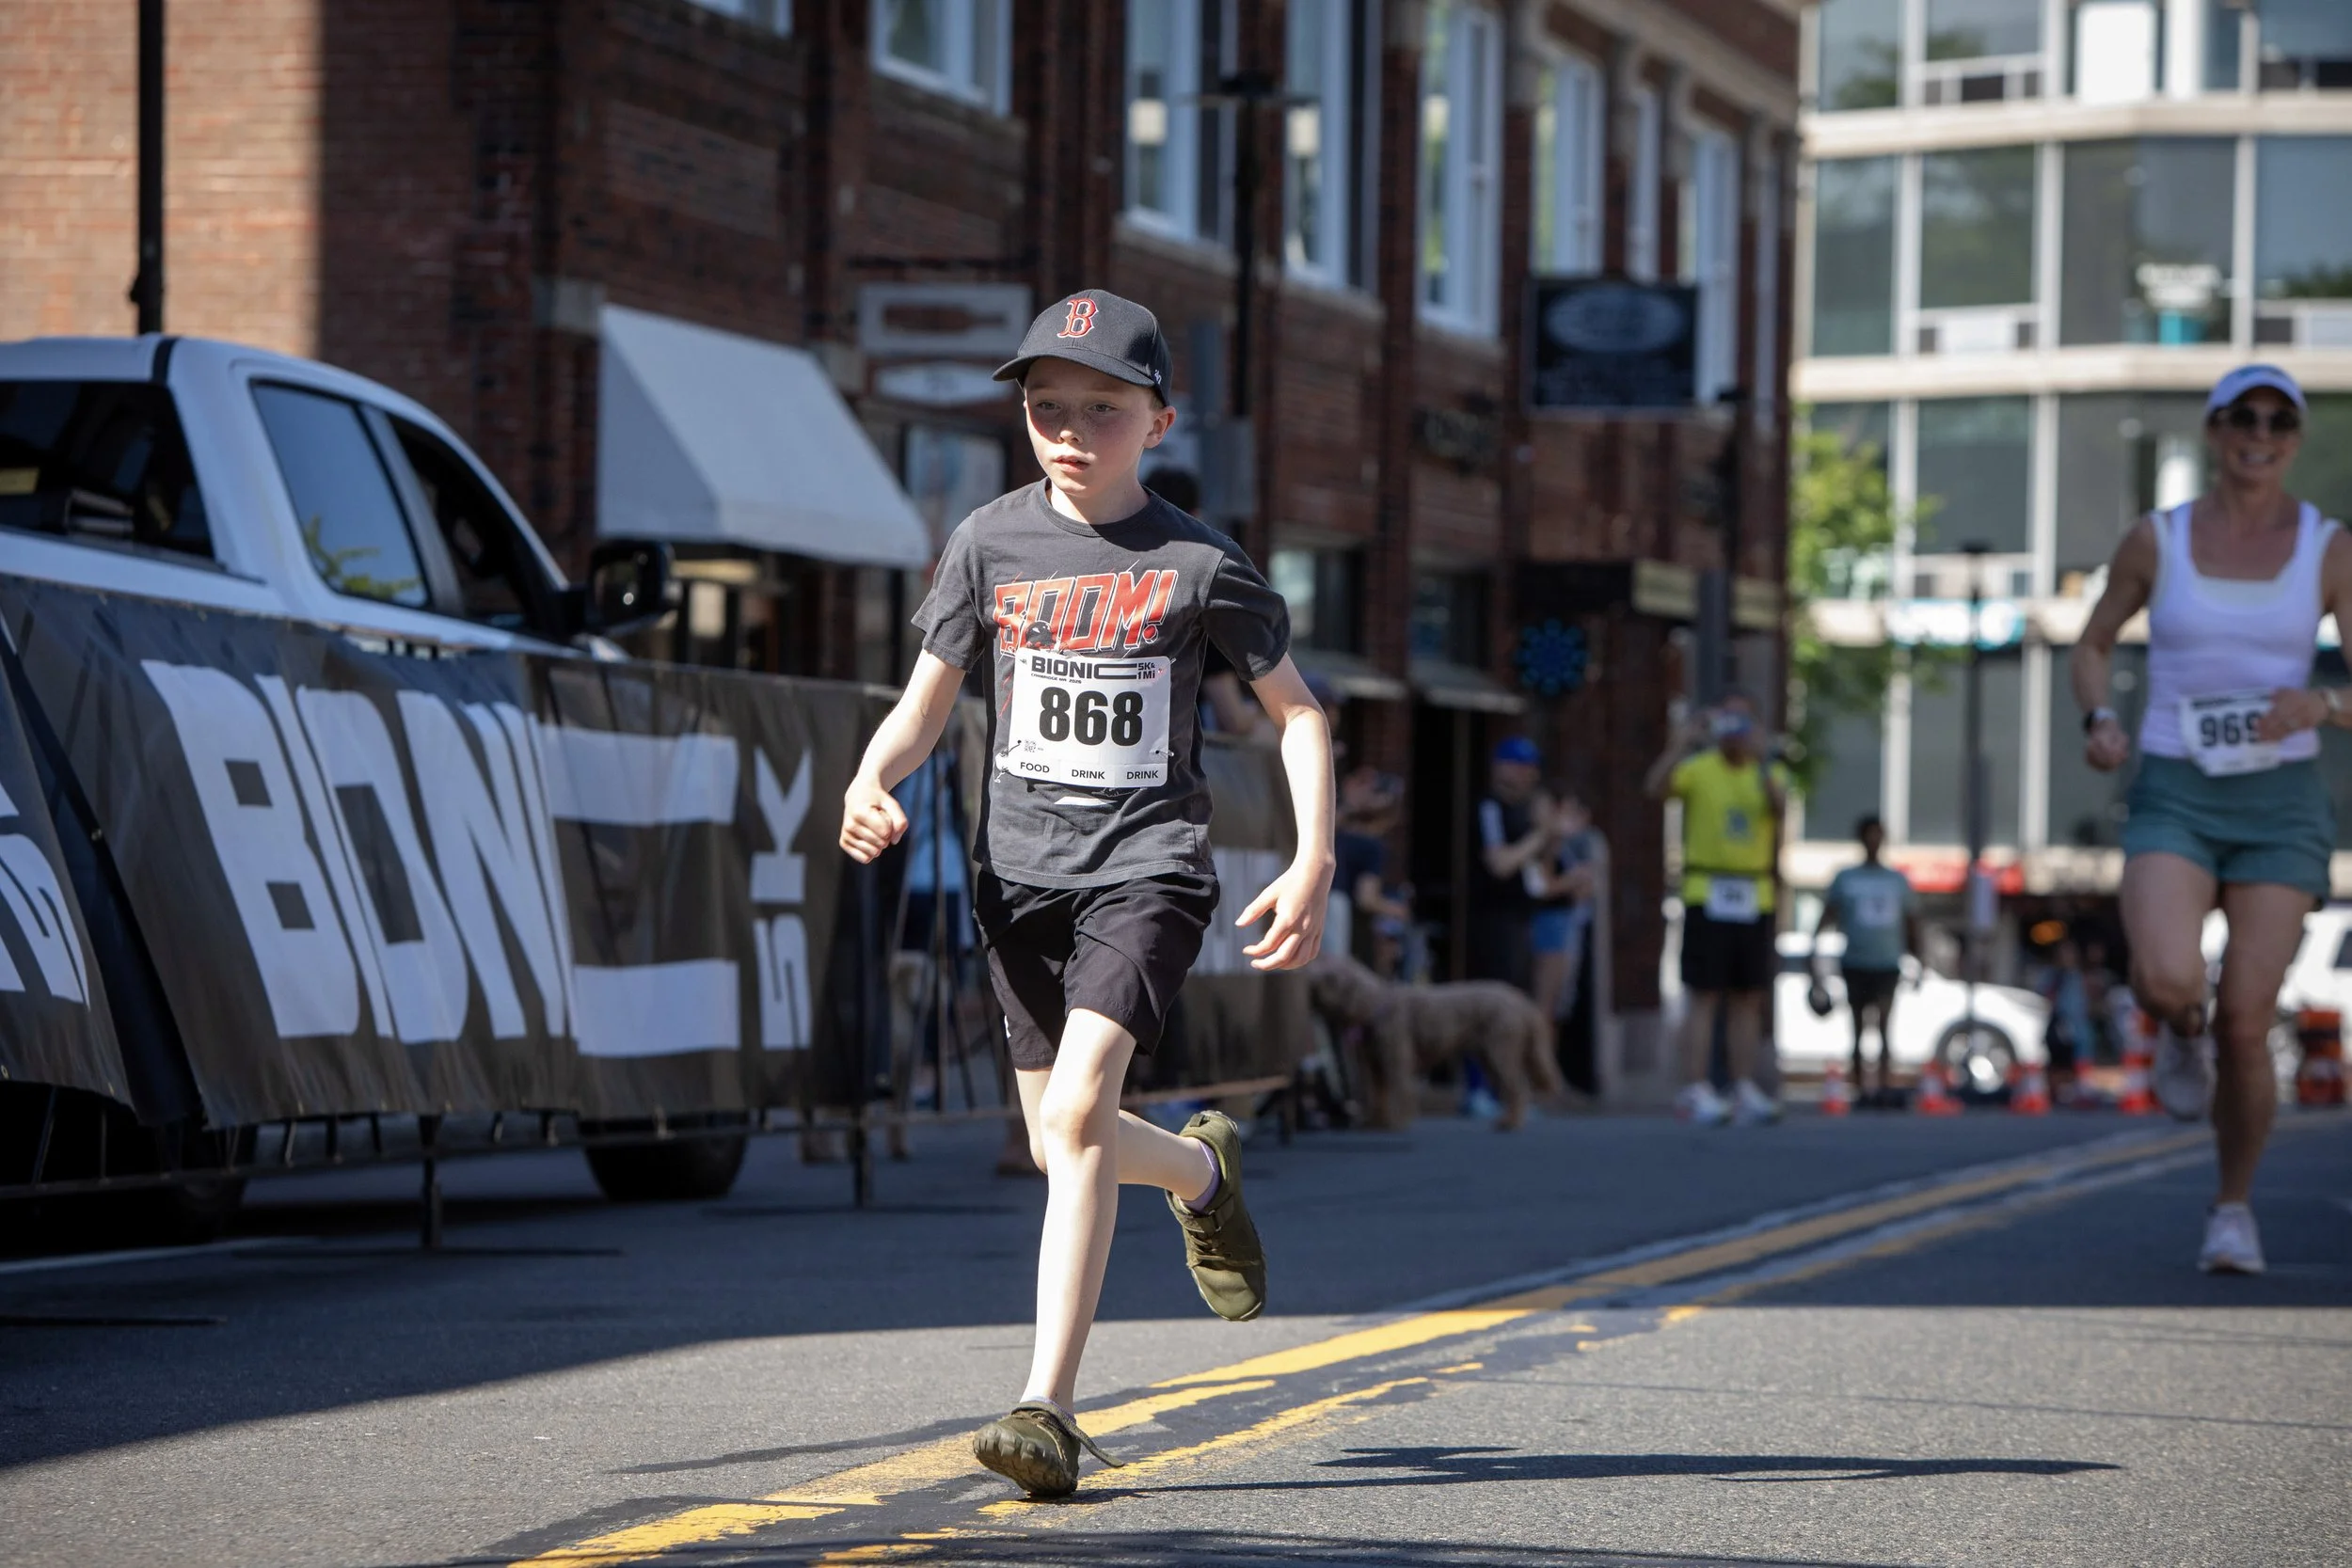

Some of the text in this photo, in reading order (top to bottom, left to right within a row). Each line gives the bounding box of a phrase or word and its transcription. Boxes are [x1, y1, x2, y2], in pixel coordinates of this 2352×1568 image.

[1057, 297, 1099, 339] B
[993, 569, 1179, 657] BOOM!
[1031, 656, 1137, 679] BIONIC
[1039, 686, 1144, 747] 868
[1020, 761, 1159, 780] FOOD DRINK DRINK
